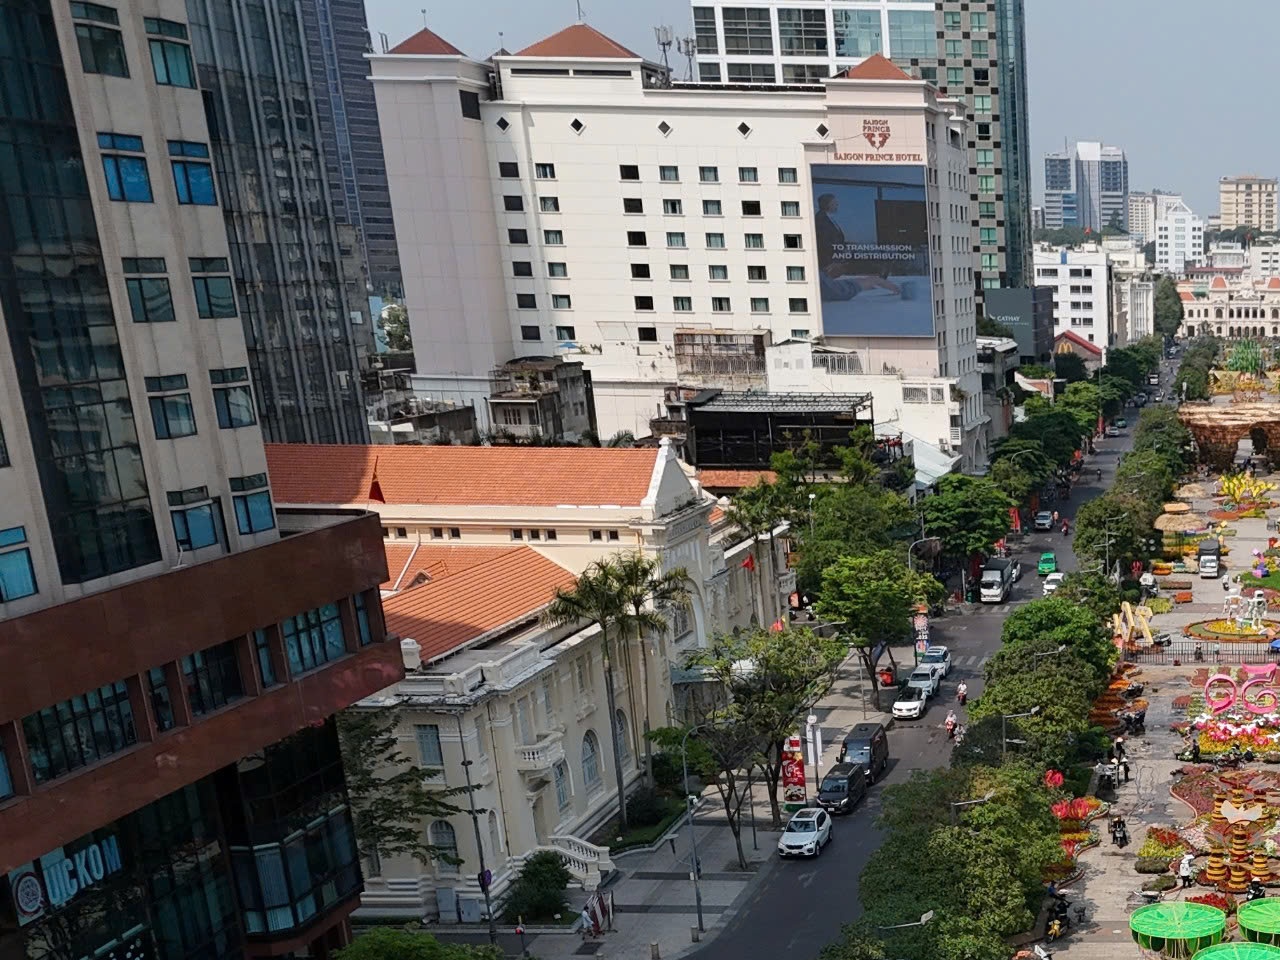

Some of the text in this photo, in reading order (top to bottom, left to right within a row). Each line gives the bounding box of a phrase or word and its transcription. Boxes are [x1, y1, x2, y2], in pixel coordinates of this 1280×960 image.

[862, 125, 891, 133] PRINCE
[833, 152, 923, 162] SAIGON PRINCE HOTEL
[846, 244, 912, 252] TRANSMISSION
[831, 252, 853, 260] AND
